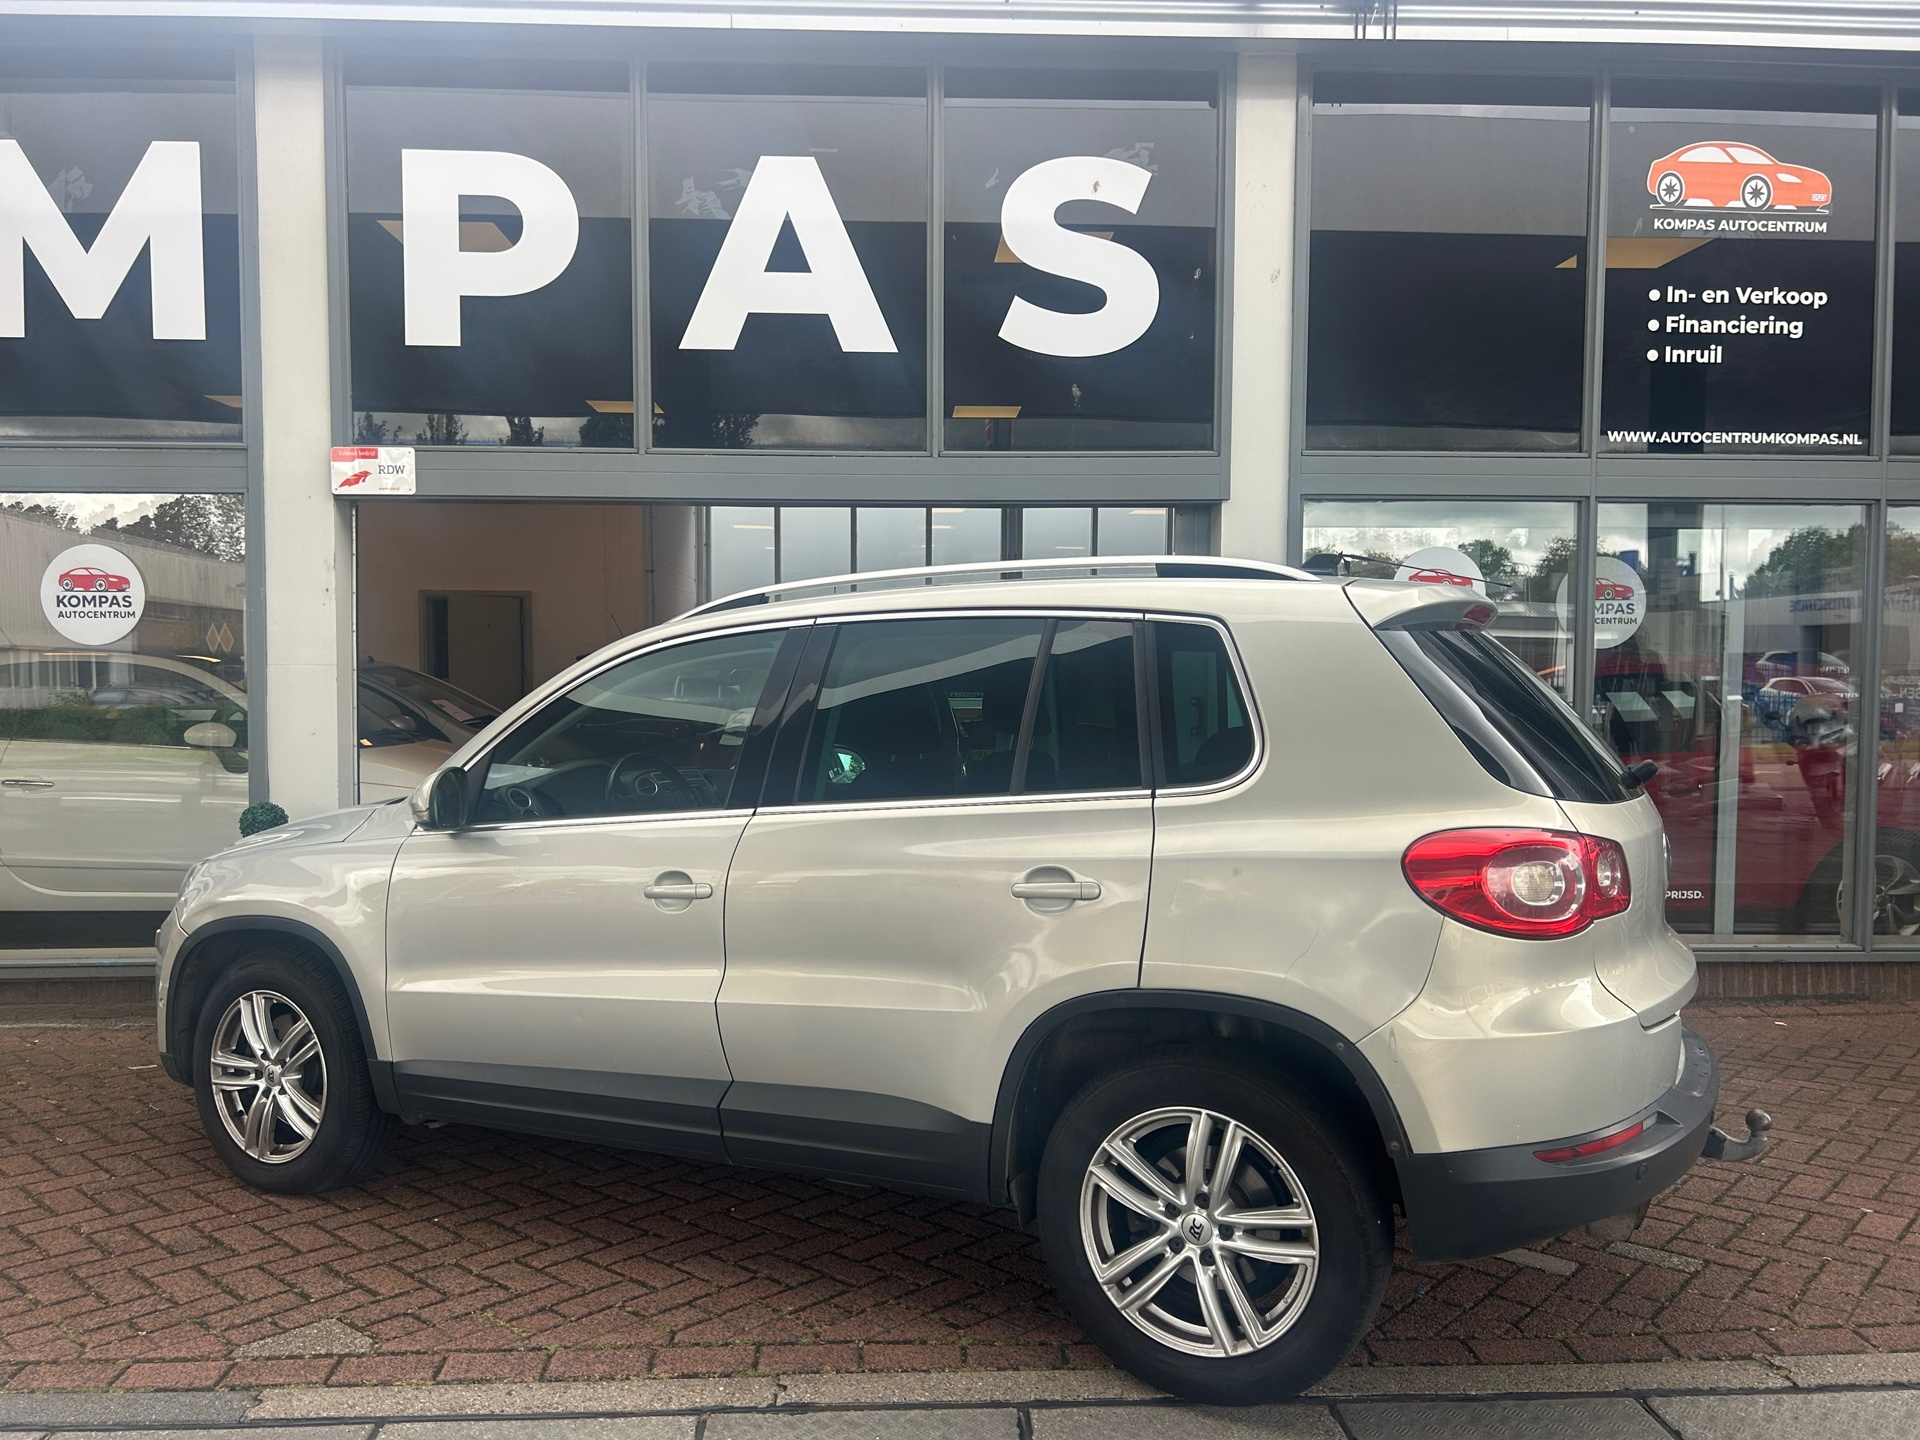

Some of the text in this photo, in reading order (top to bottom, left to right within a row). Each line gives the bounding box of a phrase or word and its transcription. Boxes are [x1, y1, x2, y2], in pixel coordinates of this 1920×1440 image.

[1654, 218, 1828, 233] KOMPAS AUTOCENTRUM
[1666, 285, 1828, 309] In- en Verkoop
[1665, 314, 1804, 339] Financiering
[1664, 344, 1723, 363] Inruil
[1607, 430, 1863, 446] WWW.AUTOCENTRUMKOMPAS.NL
[377, 464, 406, 475] RDW
[56, 595, 133, 608] KOMPAS
[57, 610, 136, 619] AUTOCENTRUM
